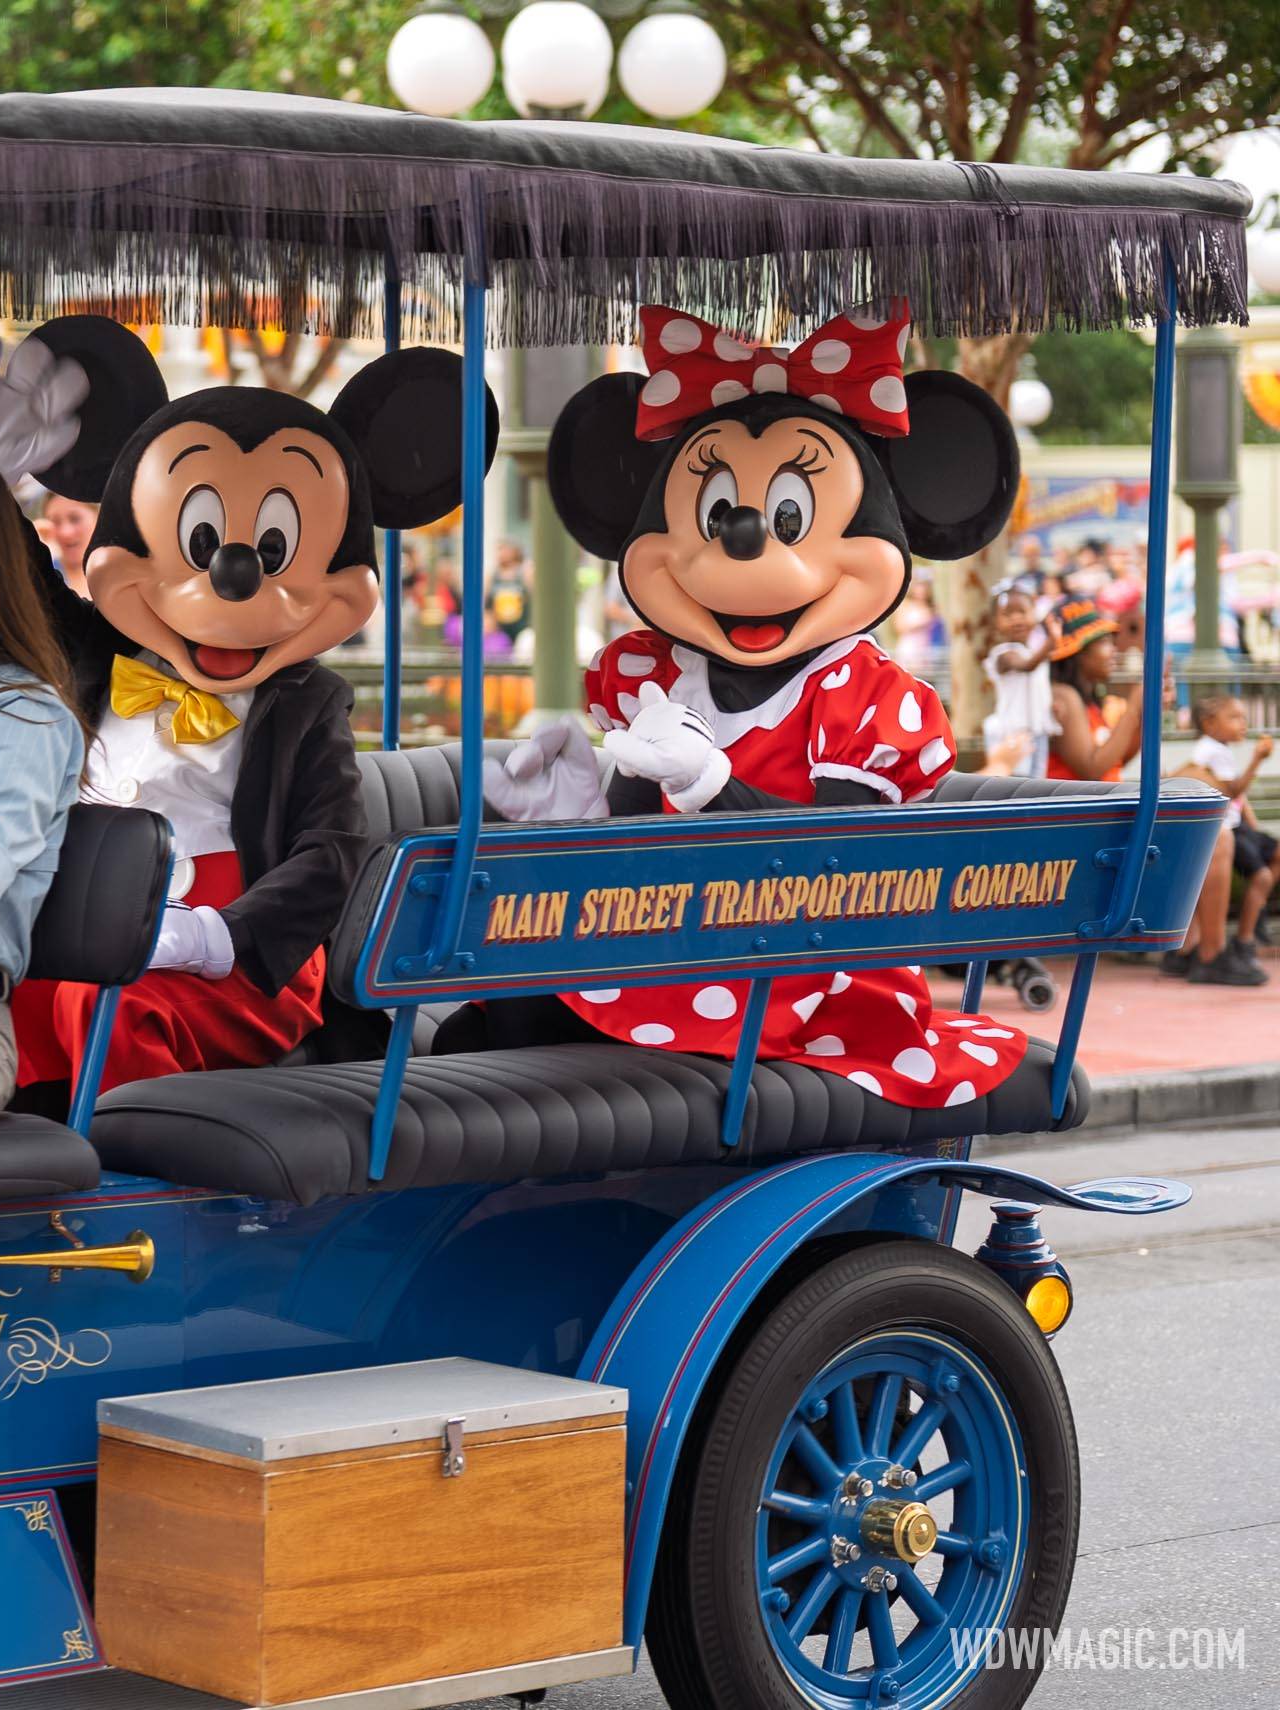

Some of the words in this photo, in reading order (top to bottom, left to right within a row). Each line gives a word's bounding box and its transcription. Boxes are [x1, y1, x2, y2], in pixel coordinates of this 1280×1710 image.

[482, 891, 569, 944] MAIN
[573, 883, 694, 940] STREET
[700, 867, 943, 930] TRANSPORTATION
[950, 859, 1077, 913] COMPANY
